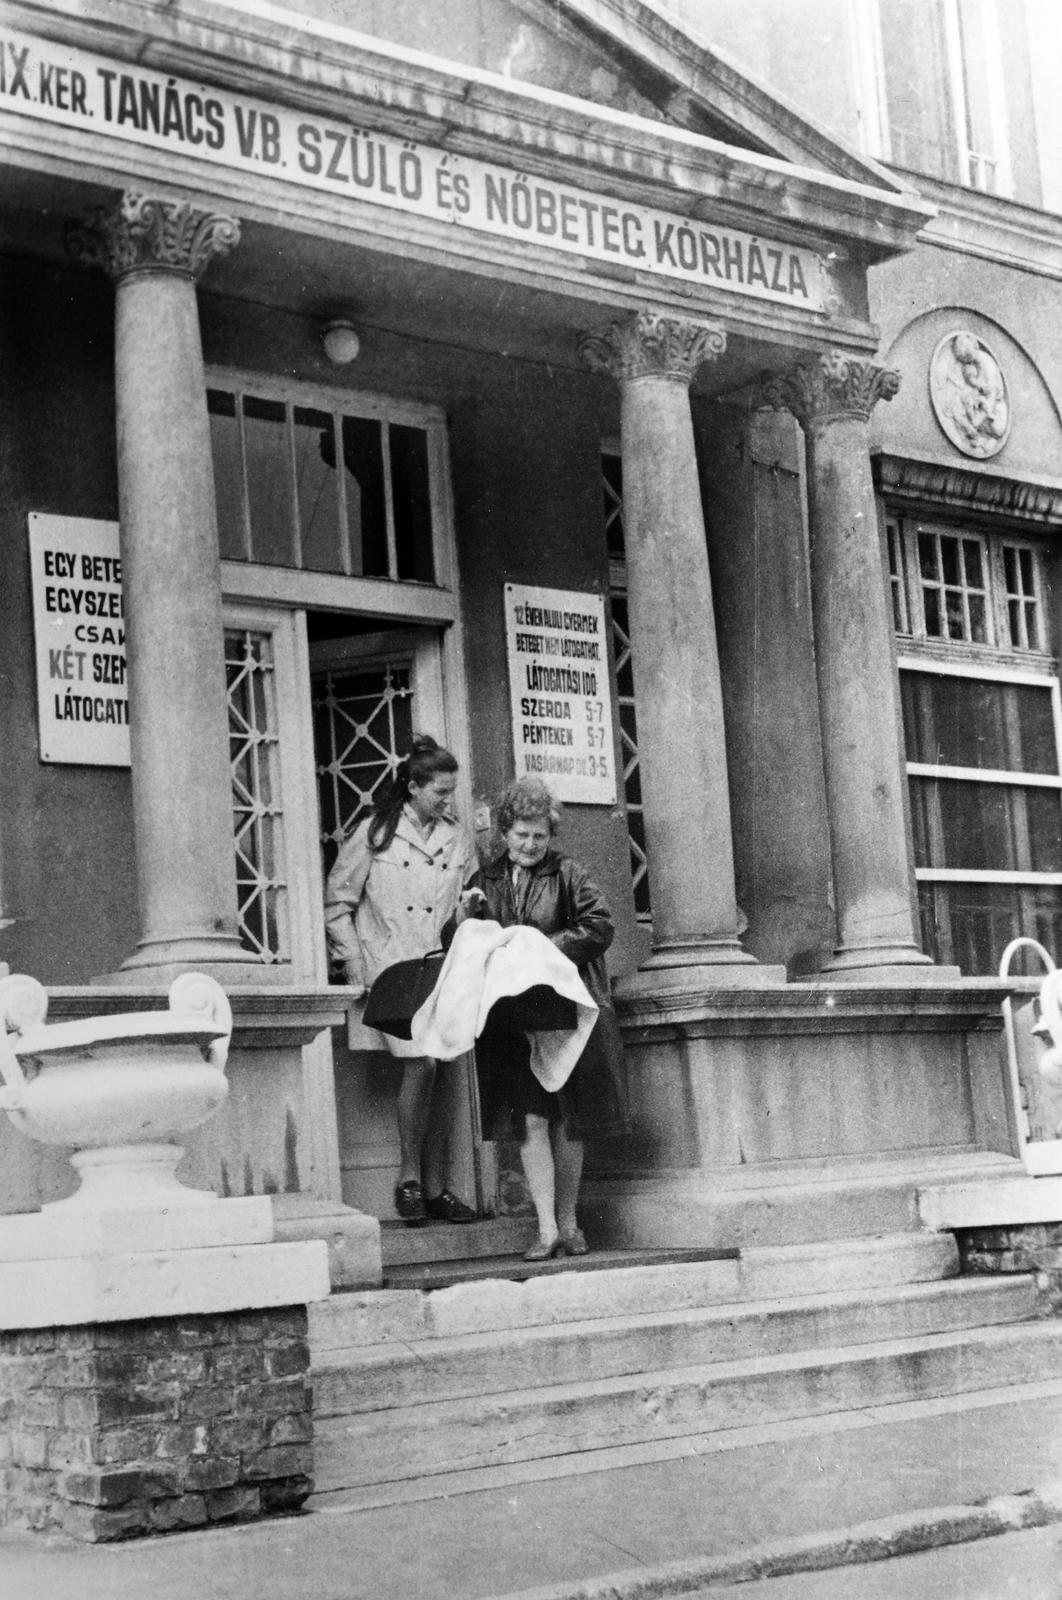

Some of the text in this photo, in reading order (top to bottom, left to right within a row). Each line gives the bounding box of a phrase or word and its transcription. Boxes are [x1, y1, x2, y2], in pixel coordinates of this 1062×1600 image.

[40, 61, 94, 117] KER.
[97, 68, 225, 150] TANÁCS
[297, 124, 422, 201] SZÜLŐ
[436, 154, 470, 214] ÉS
[484, 173, 646, 258] NŐBETEG
[653, 219, 810, 299] KÓRHÁZA
[44, 551, 76, 578] EGY
[514, 601, 599, 634] 12 ÉVEN ALULI GYERMEK
[516, 632, 544, 654] BETEGET
[49, 644, 86, 682] KÉT
[526, 659, 581, 696] LÁTOGATÁSI
[521, 697, 572, 721] SZERDA
[522, 721, 574, 746] PÉNTEKEN
[524, 750, 574, 775] VASÁRNAP
